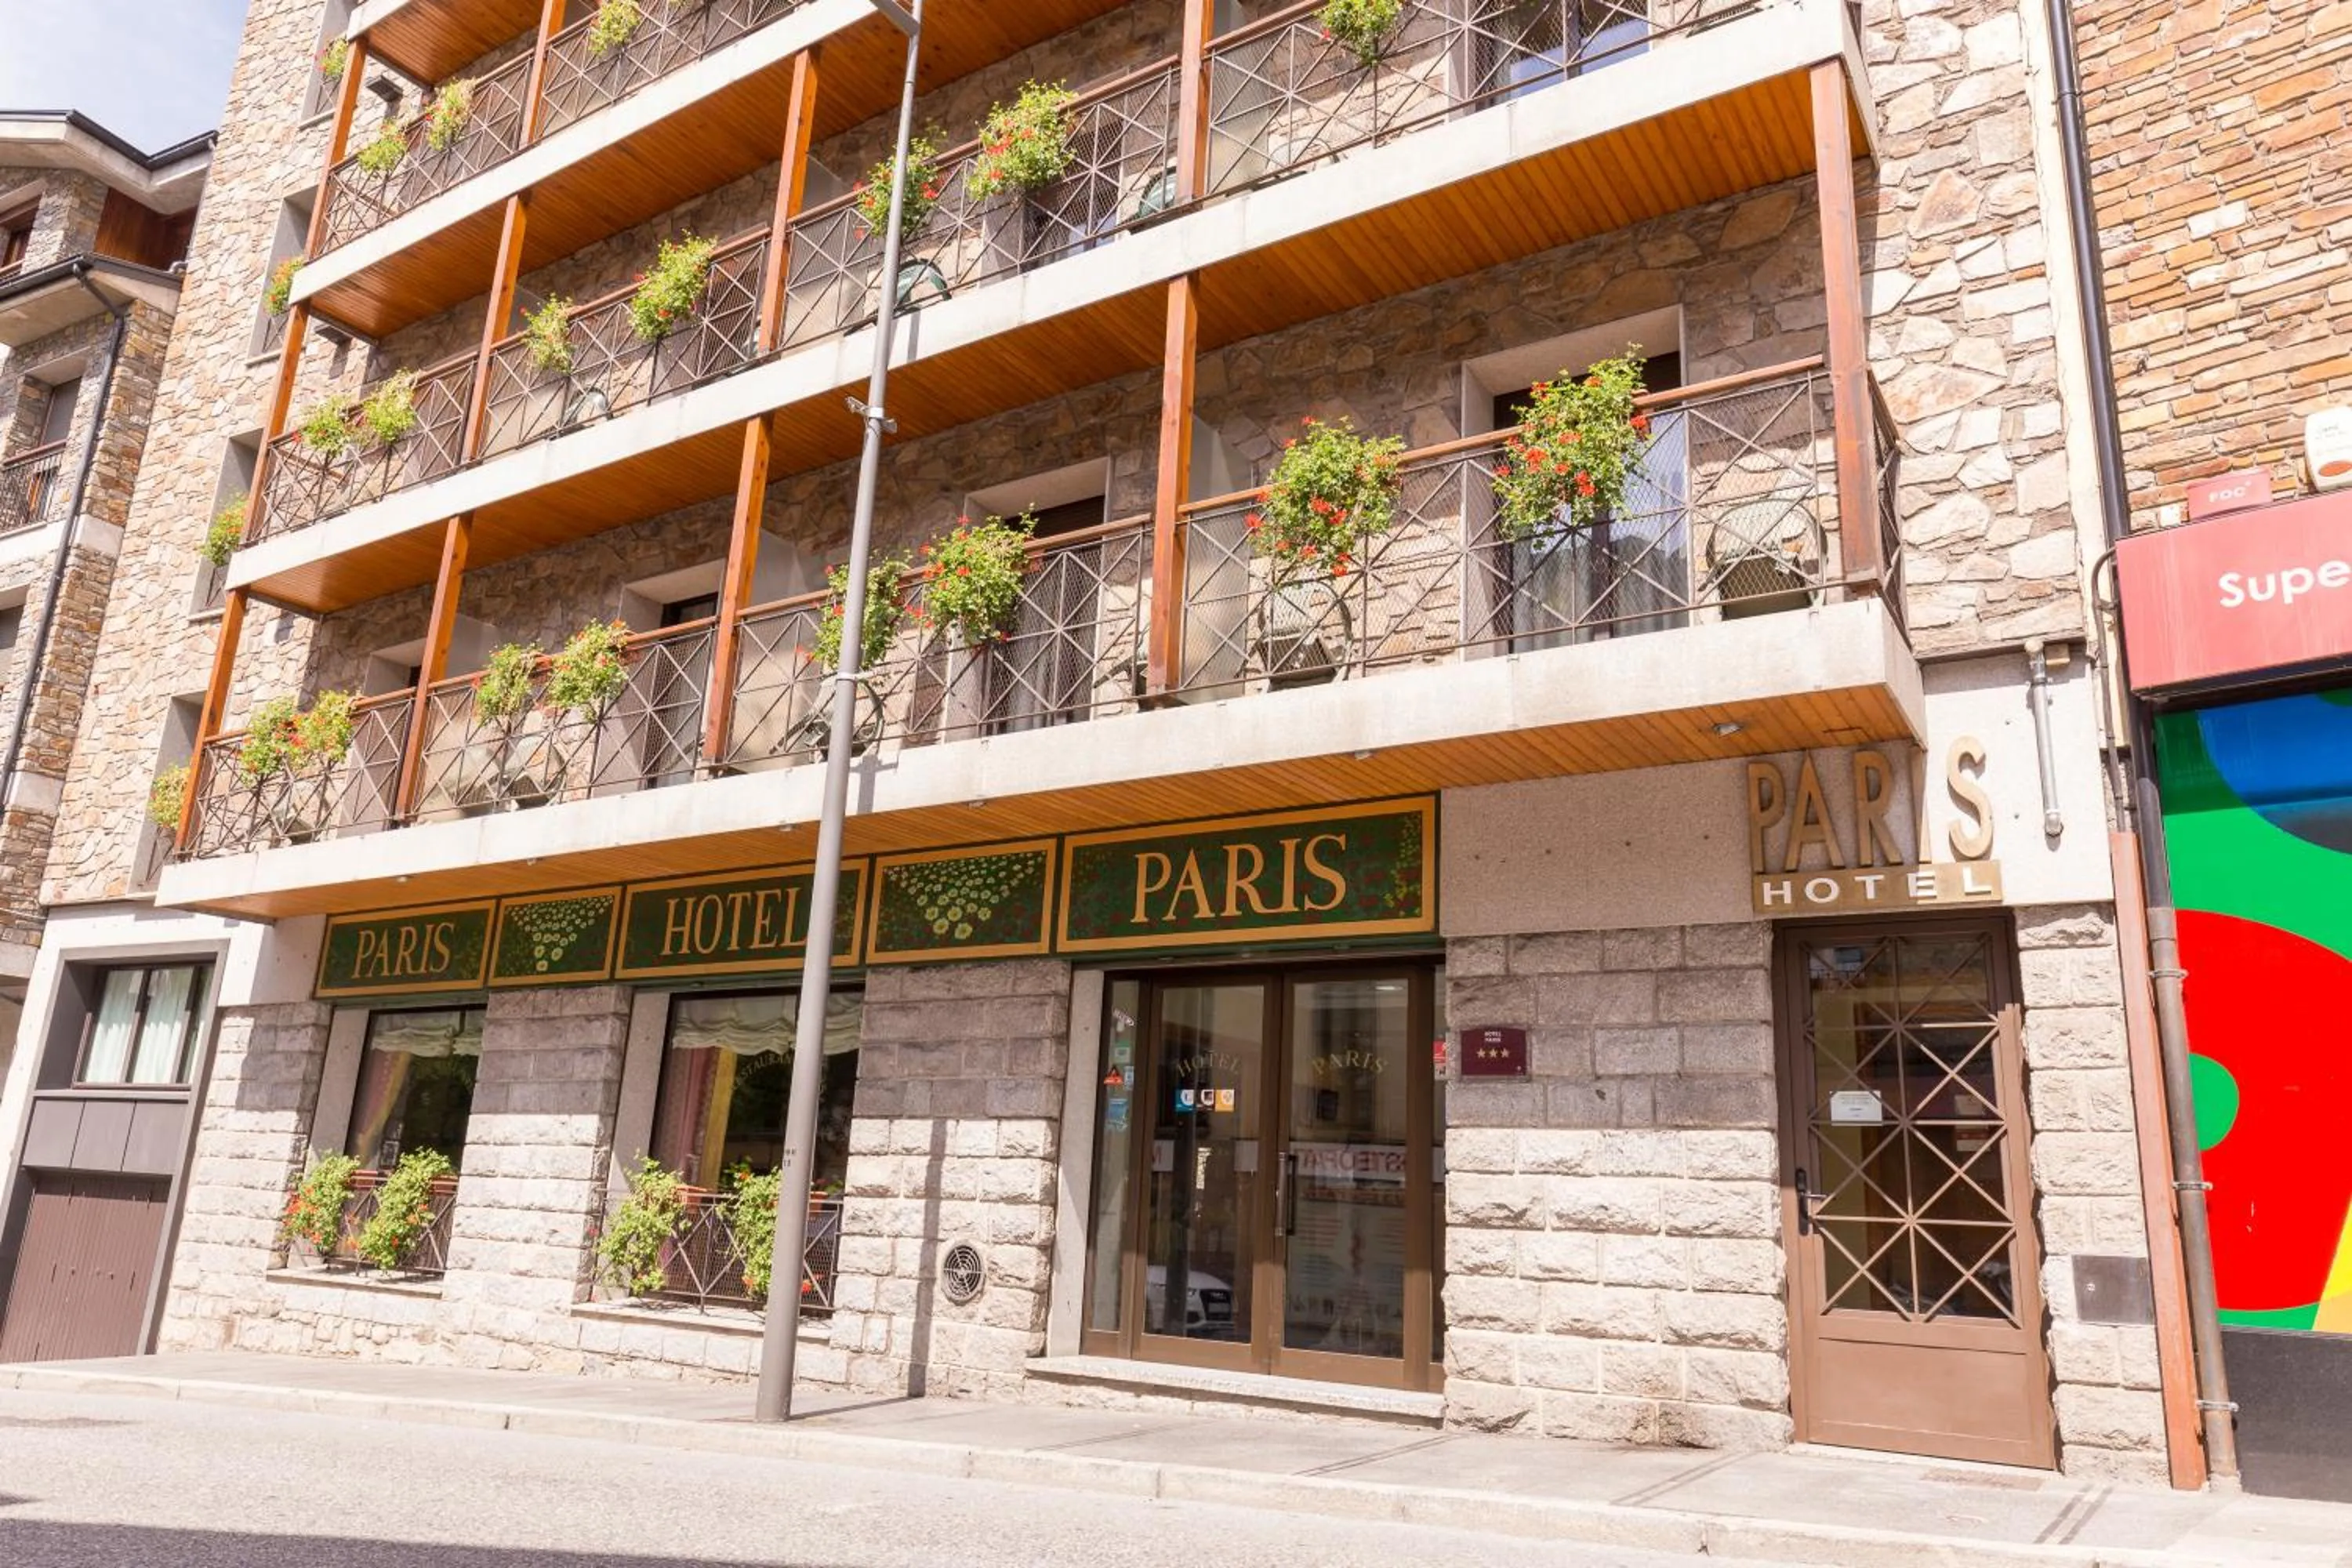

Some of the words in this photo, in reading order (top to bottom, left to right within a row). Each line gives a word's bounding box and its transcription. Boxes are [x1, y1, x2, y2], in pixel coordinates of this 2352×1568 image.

[2218, 559, 2351, 608] Supe
[1747, 735, 1994, 874] PARIS
[1130, 833, 1348, 924] PARIS
[1762, 866, 1992, 906] HOTEL
[350, 921, 456, 980] PARIS
[661, 887, 809, 956] HOTEL
[1177, 1049, 1240, 1078] HOTEL
[1311, 1048, 1388, 1076] PARIS
